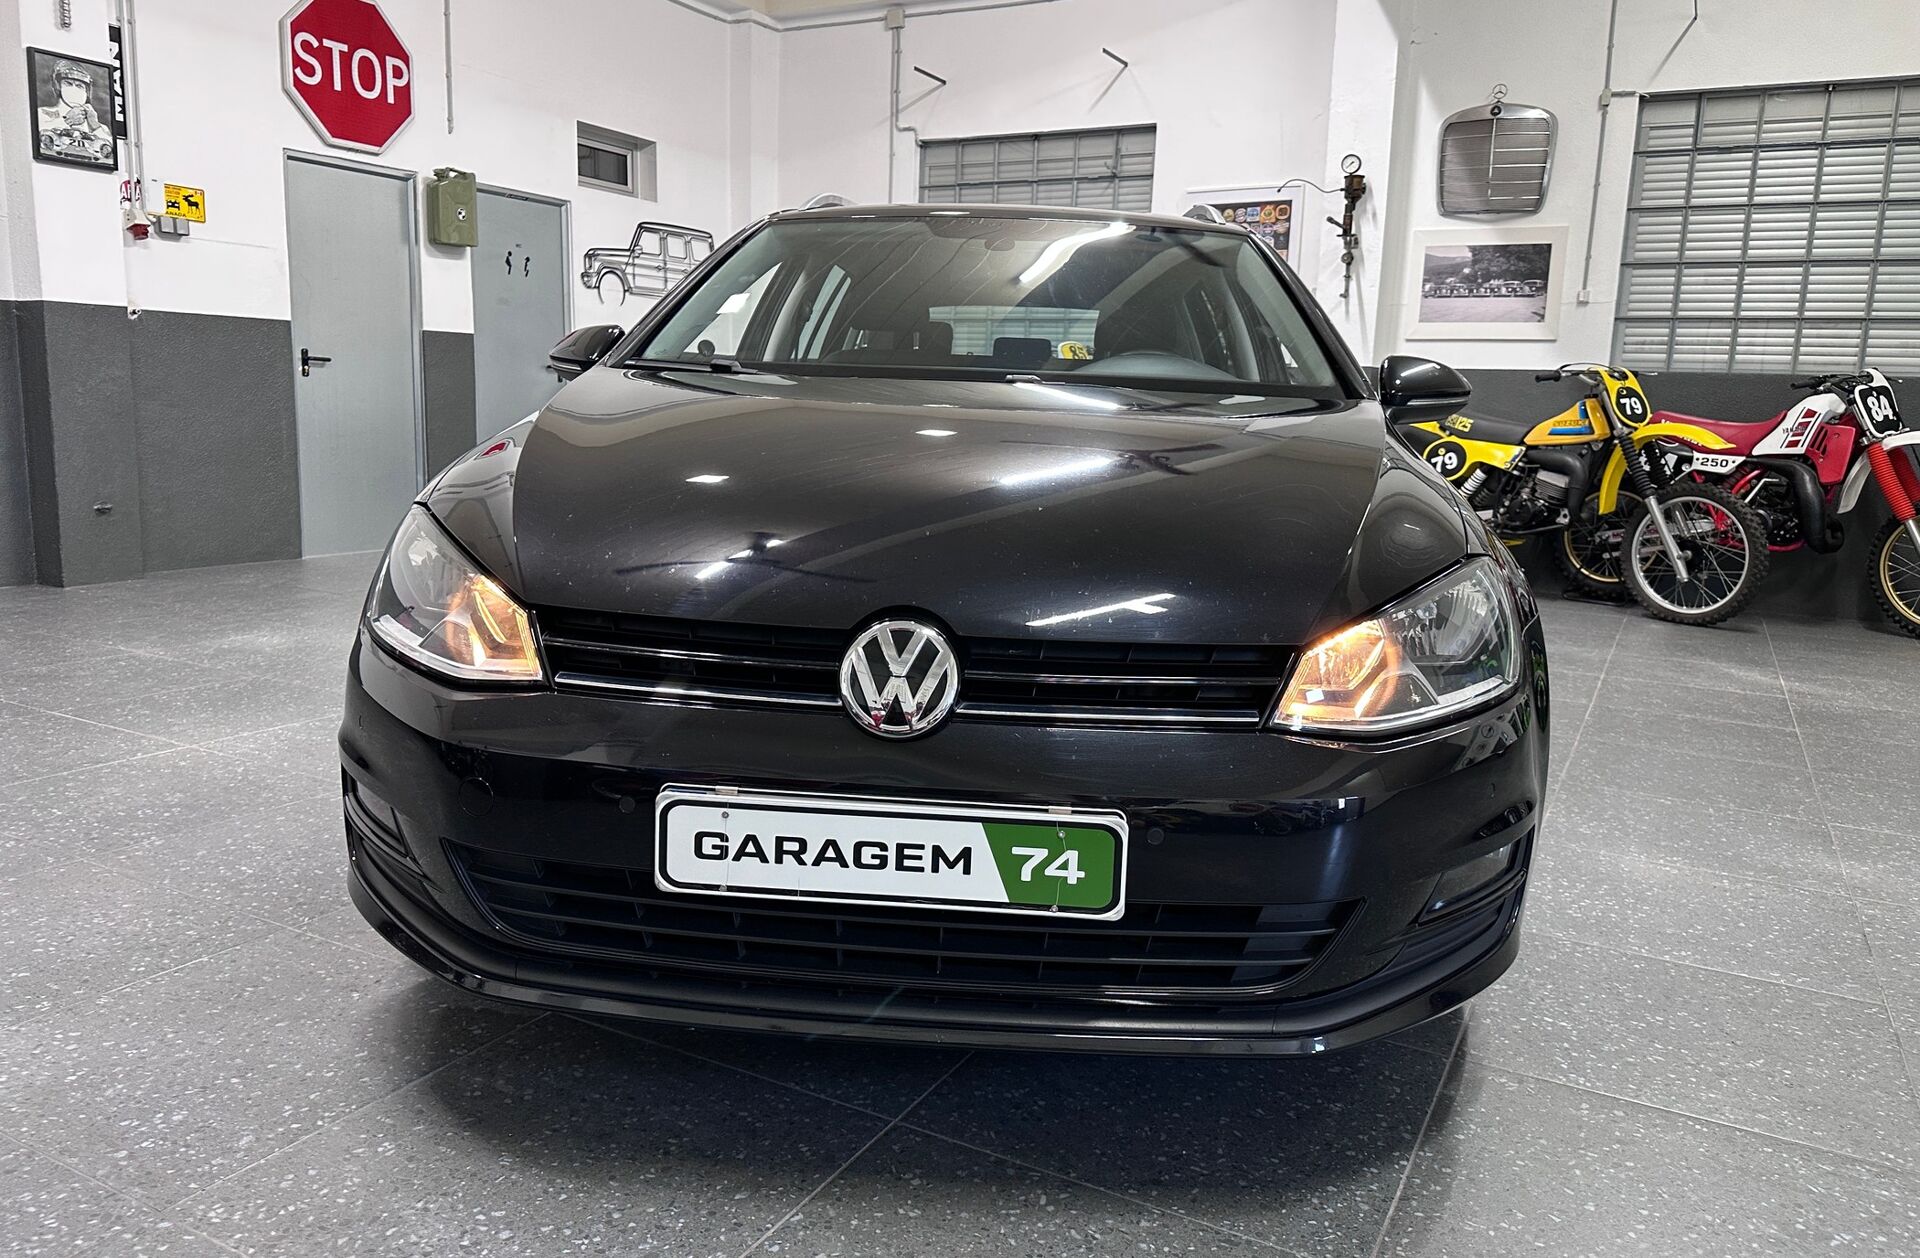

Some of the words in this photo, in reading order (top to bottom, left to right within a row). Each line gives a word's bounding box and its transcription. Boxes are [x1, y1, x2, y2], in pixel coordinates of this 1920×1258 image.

[293, 31, 410, 105] STOP
[1619, 397, 1644, 416] 79
[1866, 394, 1894, 422] 84
[1430, 451, 1458, 473] 79
[1700, 457, 1729, 468] 250
[693, 830, 973, 876] GARAGEM
[1010, 846, 1086, 885] 74
